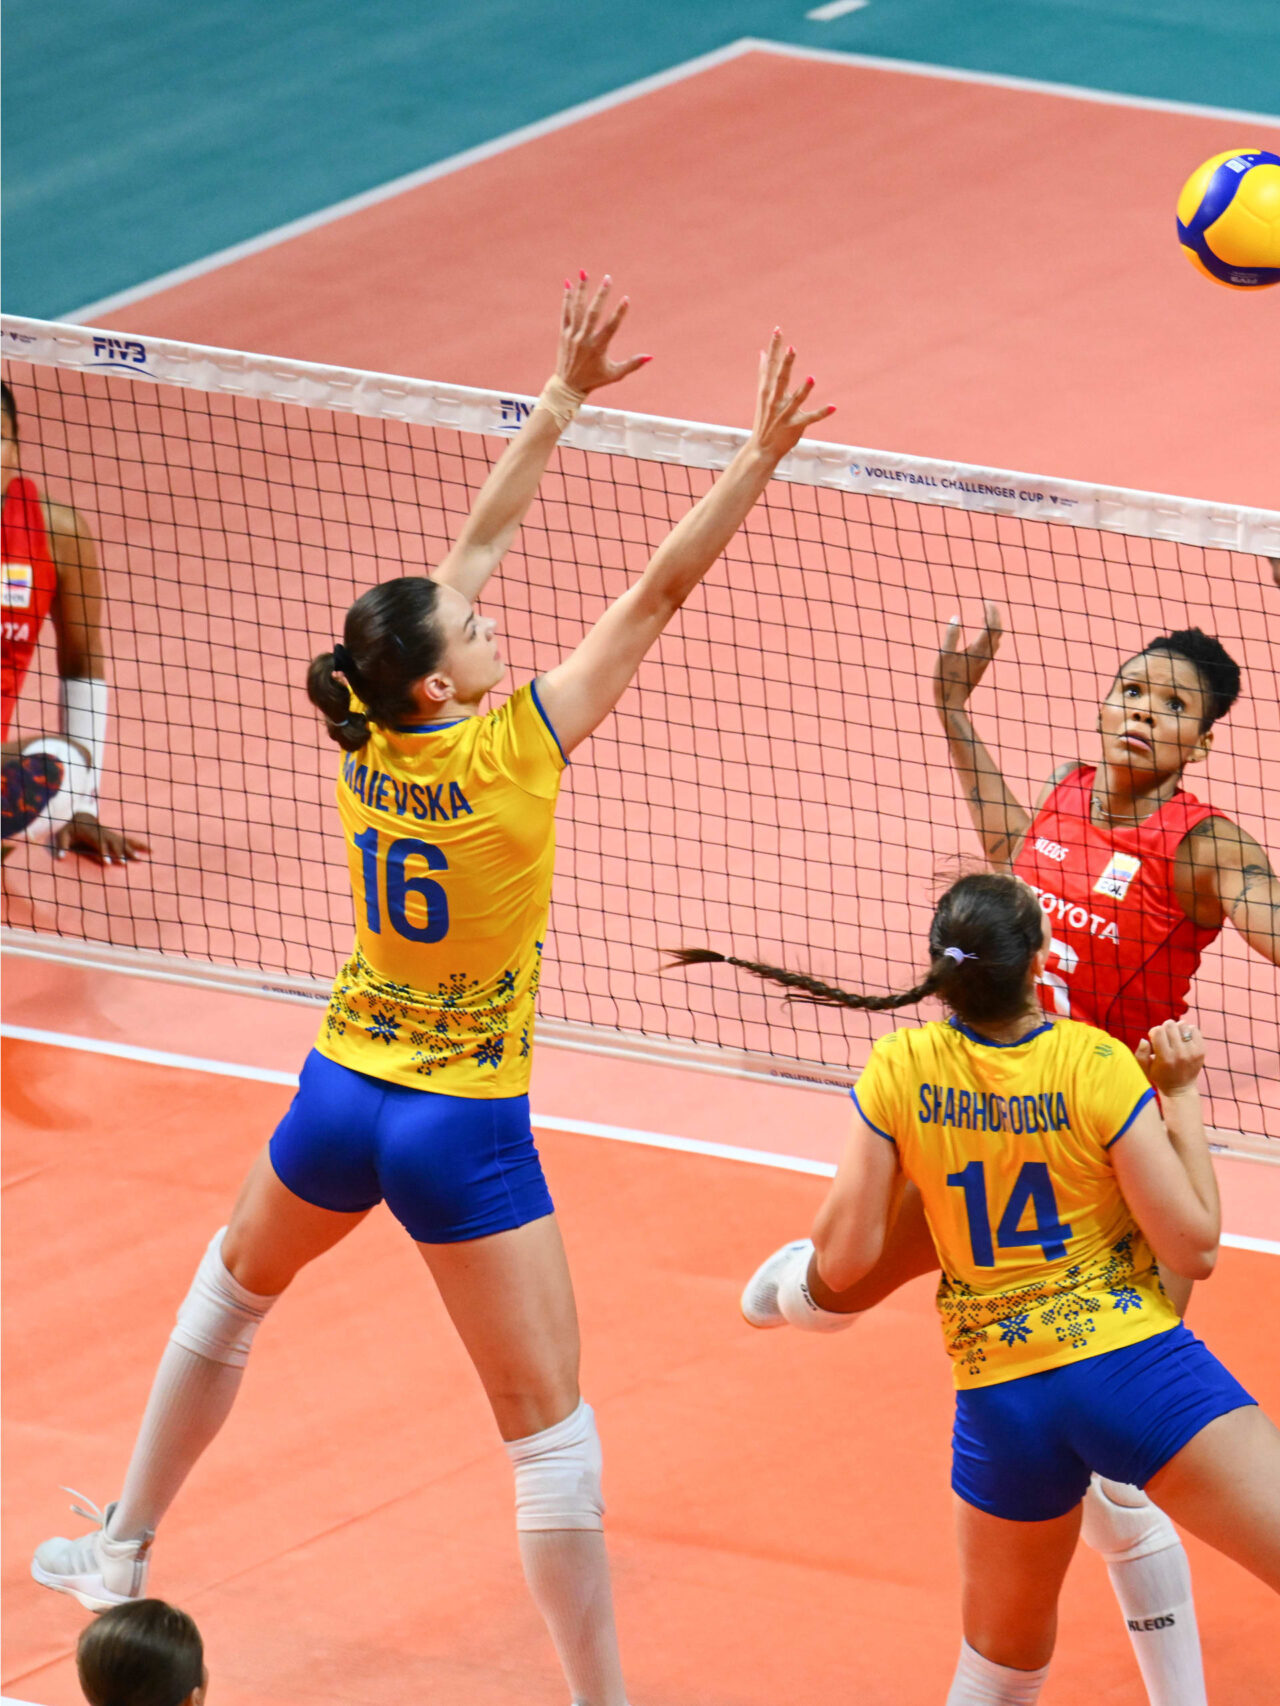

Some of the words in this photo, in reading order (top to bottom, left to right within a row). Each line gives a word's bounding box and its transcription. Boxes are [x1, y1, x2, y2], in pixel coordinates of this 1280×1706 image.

[92, 336, 146, 363] FIVB
[500, 400, 535, 422] FIV
[865, 466, 937, 487] VOLLEYBALL
[941, 478, 1016, 499] CHALLENGER
[1019, 491, 1043, 503] CUP
[354, 827, 449, 944] 16
[947, 1161, 1073, 1267] 14
